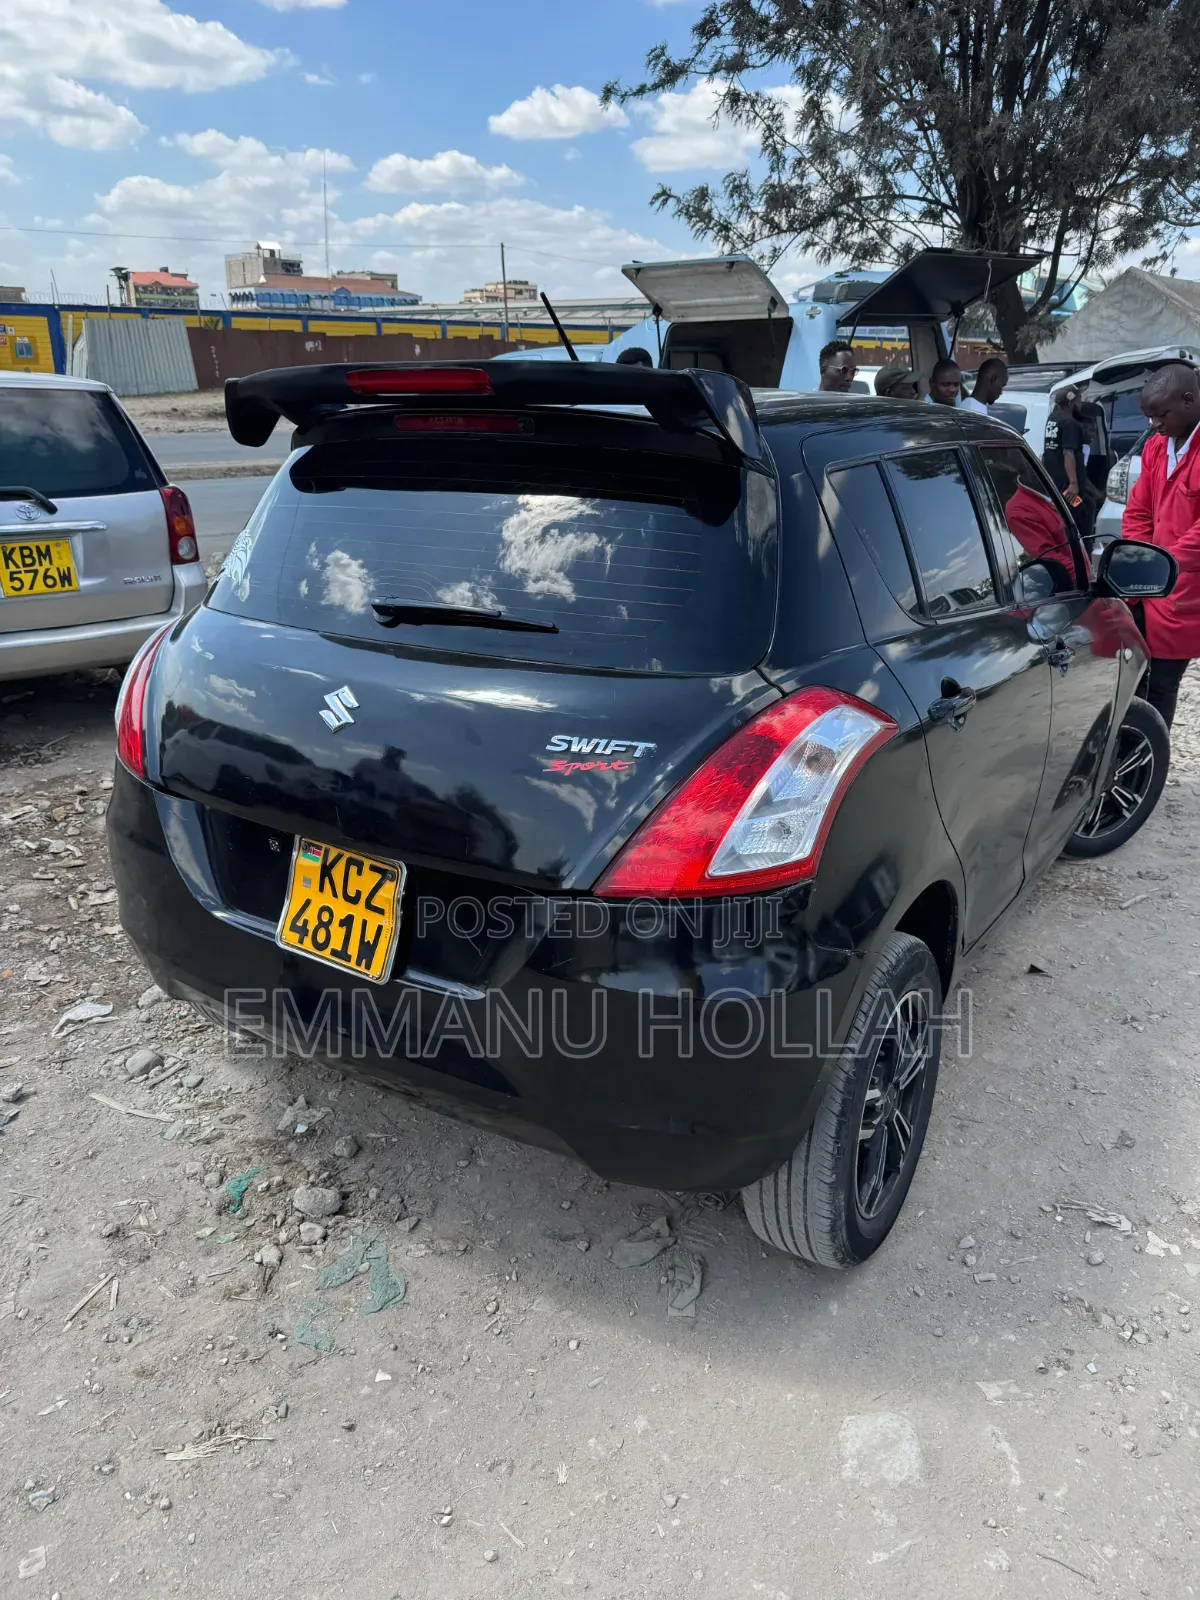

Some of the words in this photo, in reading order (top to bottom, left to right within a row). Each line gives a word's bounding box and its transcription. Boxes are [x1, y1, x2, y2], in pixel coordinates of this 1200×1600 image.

[2, 544, 54, 570] KBM
[9, 566, 73, 592] 576W
[545, 734, 658, 758] SWIFT
[318, 847, 394, 916] KCZ
[289, 898, 384, 970] 481W
